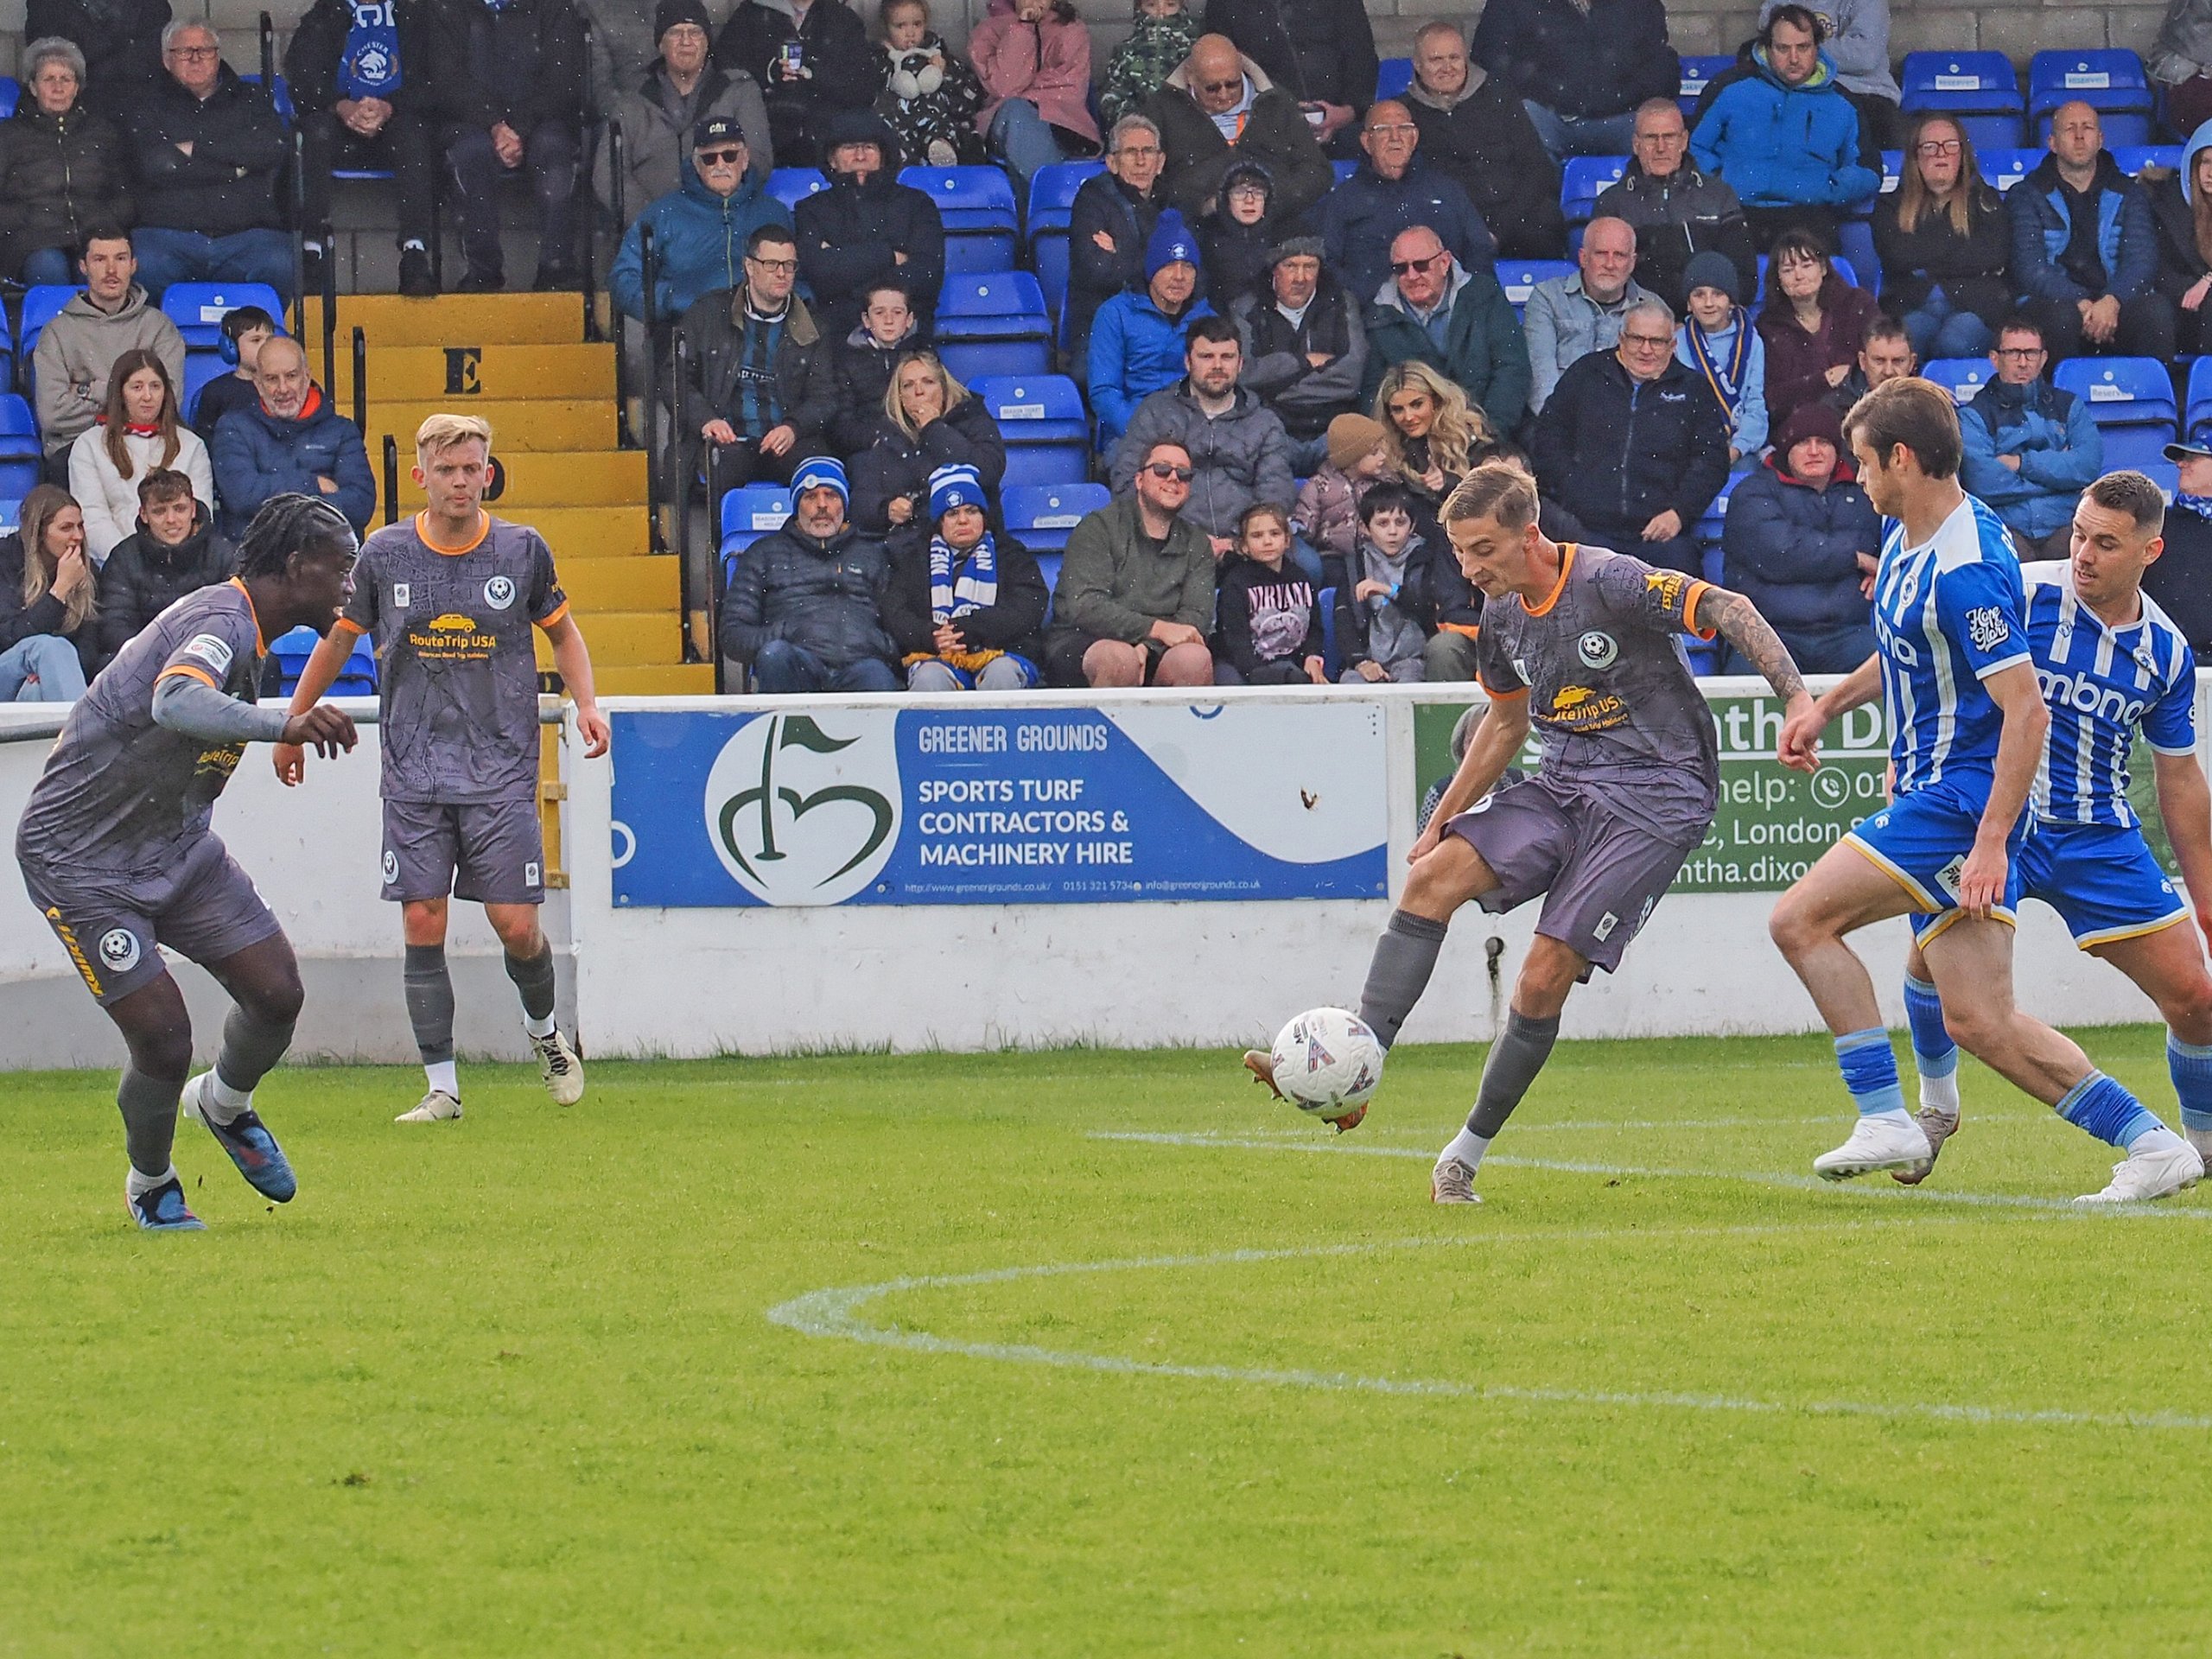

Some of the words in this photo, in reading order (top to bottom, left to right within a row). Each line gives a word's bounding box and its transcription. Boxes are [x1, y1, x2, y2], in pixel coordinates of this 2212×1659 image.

[709, 122, 727, 134] CAT
[443, 347, 481, 395] E
[931, 545, 950, 576] FAN
[976, 543, 994, 570] FAN
[1248, 582, 1313, 613] NIRVANA
[1965, 606, 2001, 632] Hope
[410, 633, 469, 649] RouteTrip
[471, 635, 497, 648] USA
[1875, 602, 1919, 668] bna
[1970, 621, 2010, 652] Glory
[918, 725, 1007, 753] GREENER
[1017, 724, 1108, 753] GROUNDS
[918, 780, 1014, 804] SPORTS
[1020, 779, 1084, 802] TURF
[918, 810, 1105, 835] CONTRACTORS
[1111, 810, 1130, 833] &
[1734, 817, 1840, 845] London
[920, 842, 1069, 866] MACHINERY
[1077, 842, 1134, 864] HIRE
[1673, 856, 1817, 884] ntha.dixo
[905, 881, 1052, 893] http://www.greenergrounds.co.uk/
[1063, 881, 1087, 891] 0151
[1090, 880, 1107, 891] 321
[1109, 880, 1134, 891] 5734
[1146, 880, 1261, 892] info@greenergrounds.co.uk
